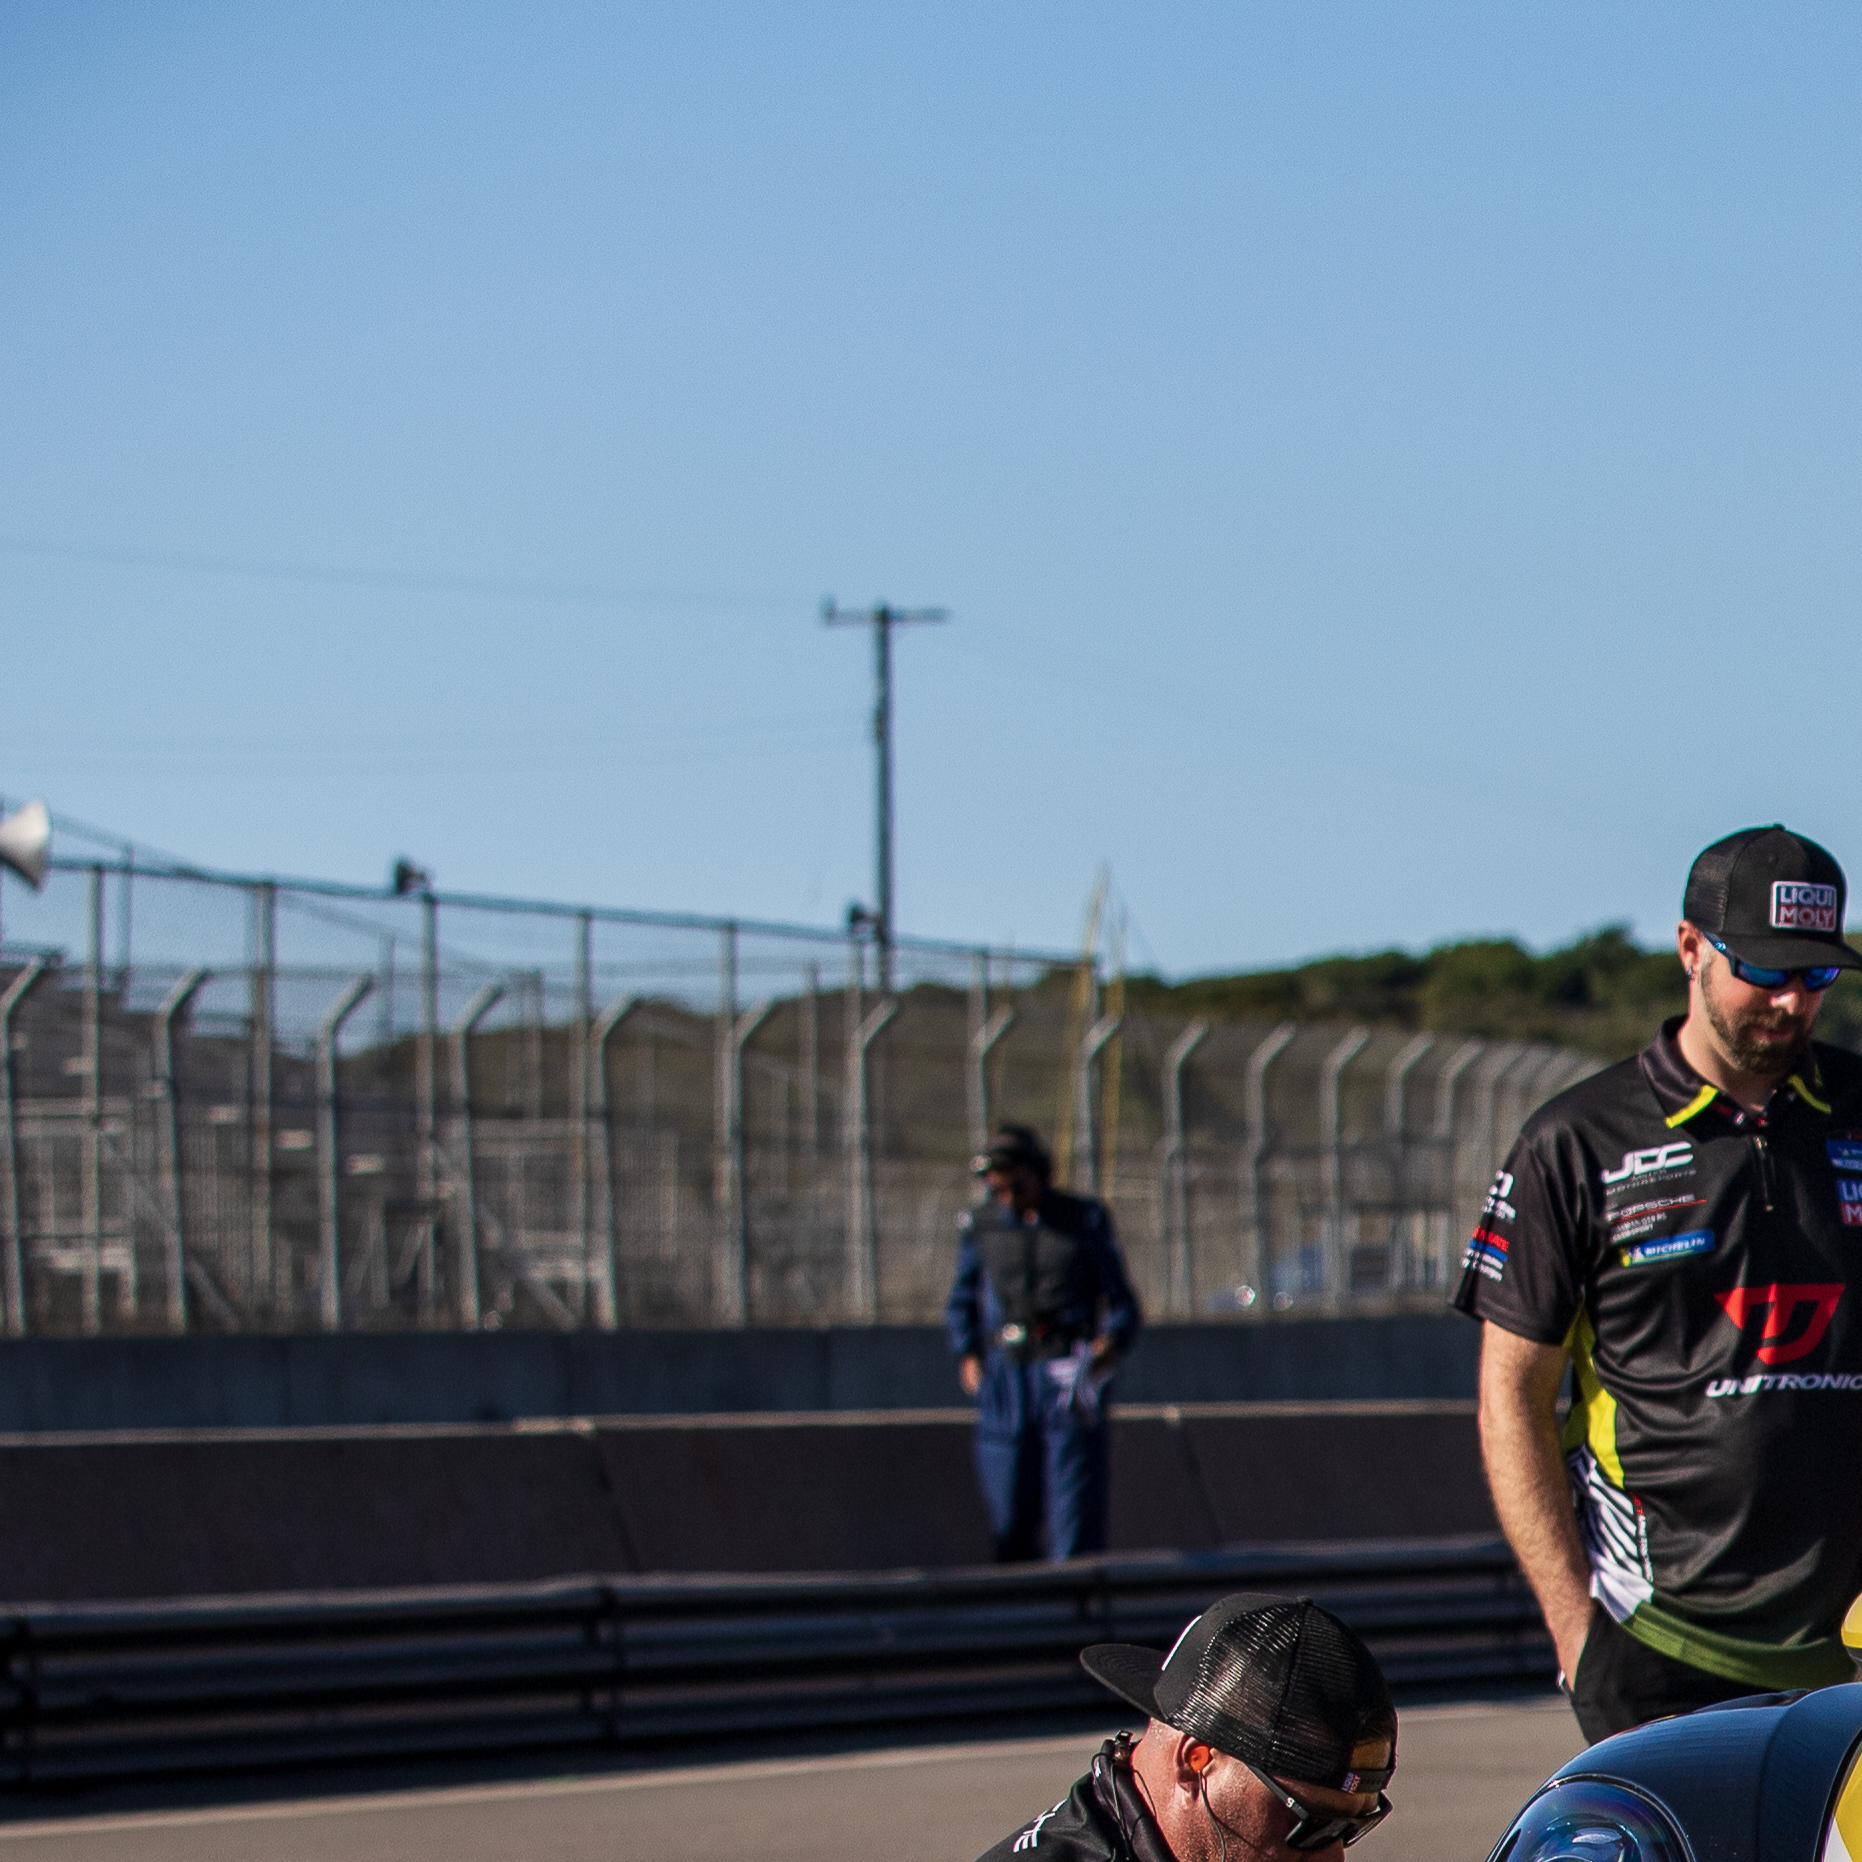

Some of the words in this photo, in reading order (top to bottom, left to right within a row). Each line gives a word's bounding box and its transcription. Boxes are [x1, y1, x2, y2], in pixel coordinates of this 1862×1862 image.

[1781, 887, 1833, 906] LIQUI
[1780, 906, 1833, 927] MOLY
[1601, 1141, 1694, 1184] JDC
